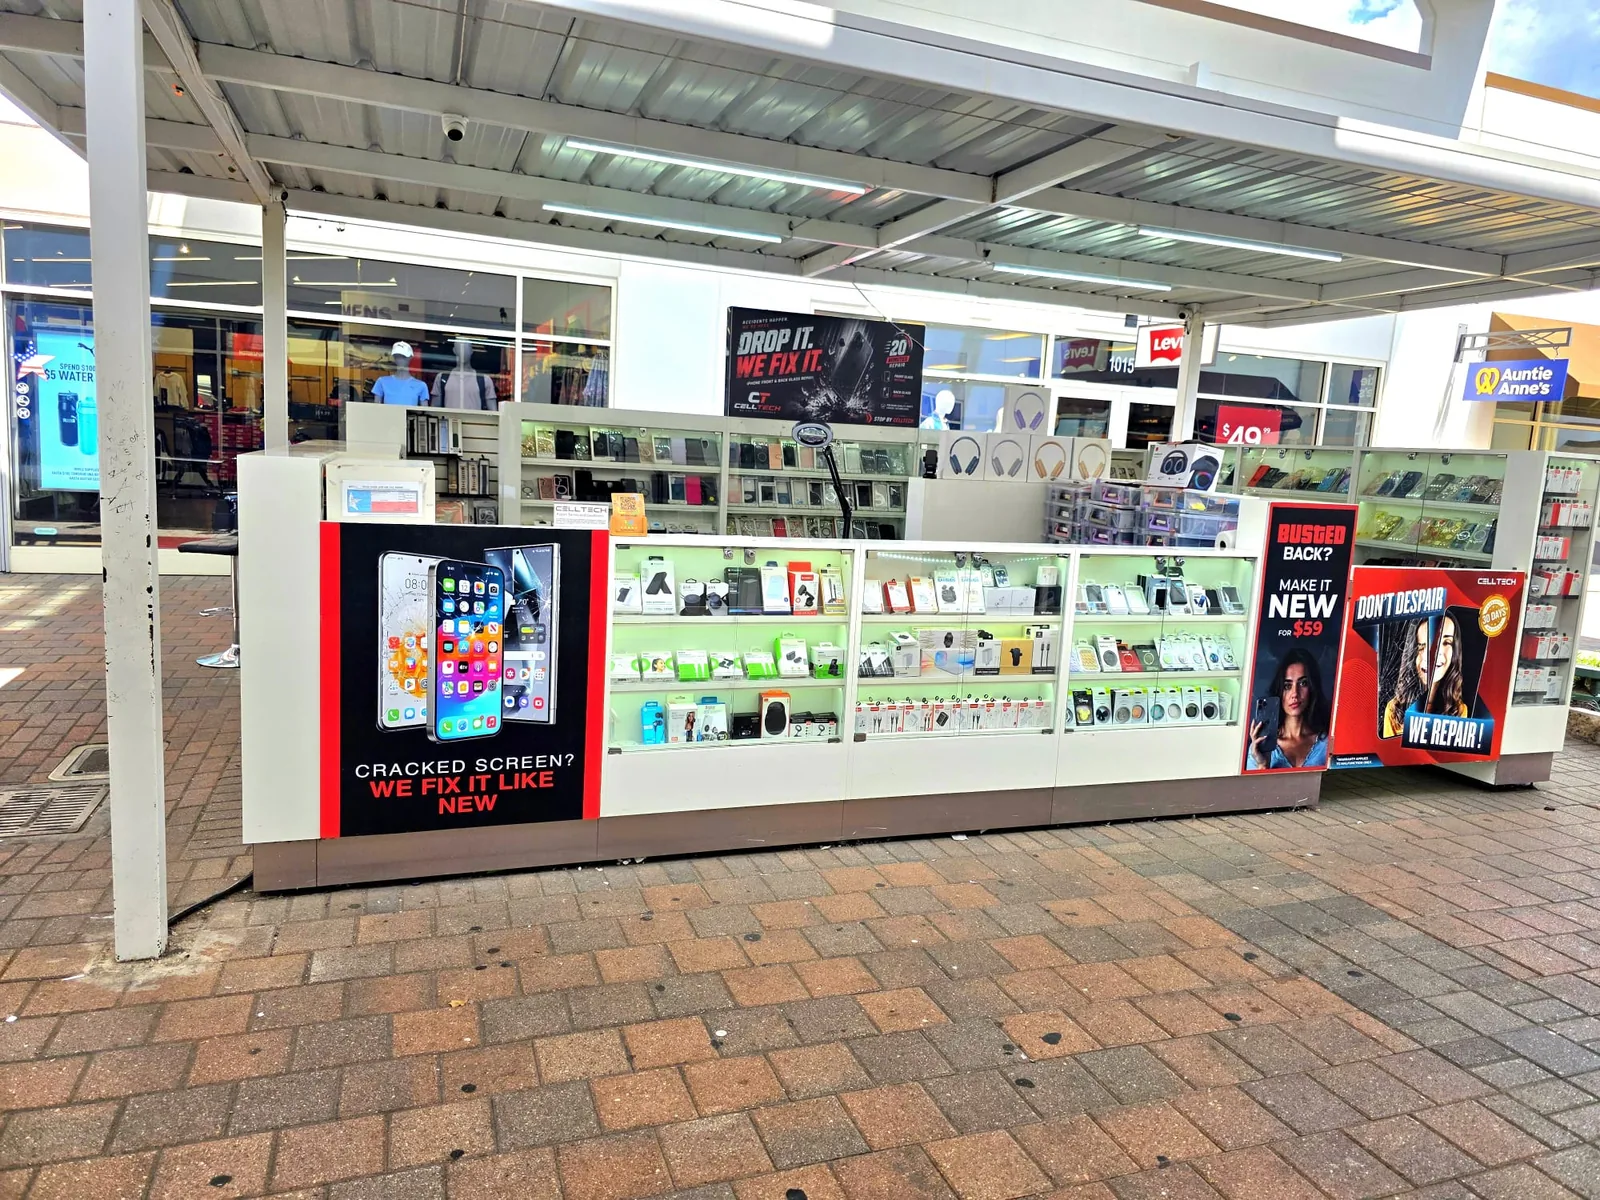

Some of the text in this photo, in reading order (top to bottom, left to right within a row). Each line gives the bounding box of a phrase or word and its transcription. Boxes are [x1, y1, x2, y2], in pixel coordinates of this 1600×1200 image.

[737, 326, 814, 355] DROP IT.
[889, 340, 907, 356] 20
[1154, 336, 1184, 351] Levi
[736, 349, 823, 379] WE FIX IT.
[1109, 356, 1135, 374] 1015
[59, 371, 94, 382] WATER
[1501, 366, 1553, 381] Auntie
[1498, 382, 1550, 395] Anne's
[734, 403, 781, 411] CELLTECH
[1283, 546, 1333, 561] BACK?
[405, 579, 427, 590] 08:0
[1280, 579, 1332, 591] MAKE IT
[1268, 594, 1338, 618] NEW
[1357, 587, 1444, 620] DON'T DESPAIR
[1482, 606, 1506, 625] 30 DAYS
[1293, 619, 1323, 638] $59
[1409, 716, 1430, 744] WE
[355, 753, 575, 779] CRACKED SCREEN?
[369, 771, 554, 798] WE FIX IT LIKE
[439, 794, 498, 814] NEW
